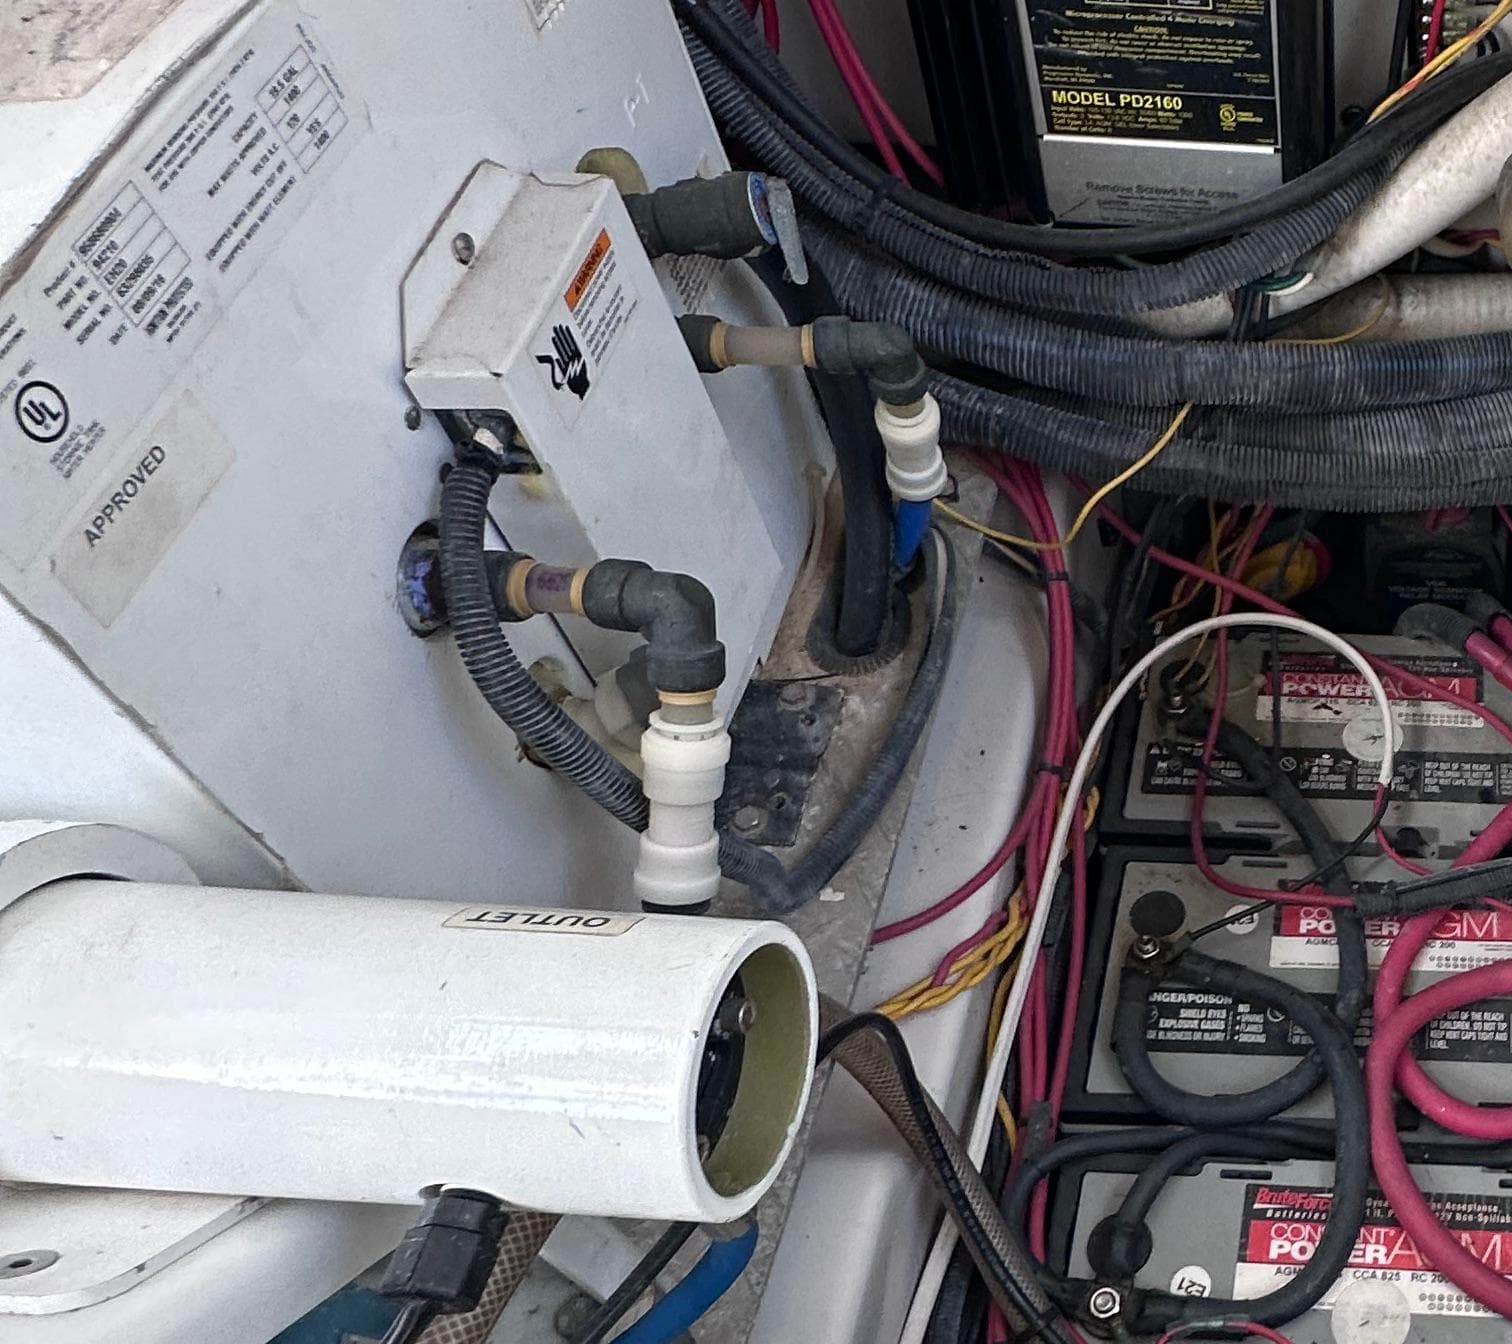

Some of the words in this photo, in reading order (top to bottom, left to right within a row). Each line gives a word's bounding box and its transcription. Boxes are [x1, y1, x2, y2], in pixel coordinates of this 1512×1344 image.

[1052, 90, 1116, 107] MODEL
[1120, 94, 1183, 111] PD2160
[1086, 181, 1133, 194] Remove
[84, 444, 166, 548] APPROVED
[1283, 672, 1370, 685] CONSTAN
[1282, 682, 1374, 698] POWER
[466, 910, 611, 927] OUTLET
[1299, 918, 1399, 937] POER
[1150, 992, 1232, 1005] NGER/POISON
[1265, 1207, 1328, 1221] Batteries
[1268, 1241, 1388, 1265] POER
[1353, 1269, 1378, 1281] CCA
[1380, 1270, 1402, 1282] 825
[1411, 1272, 1428, 1283] RC
